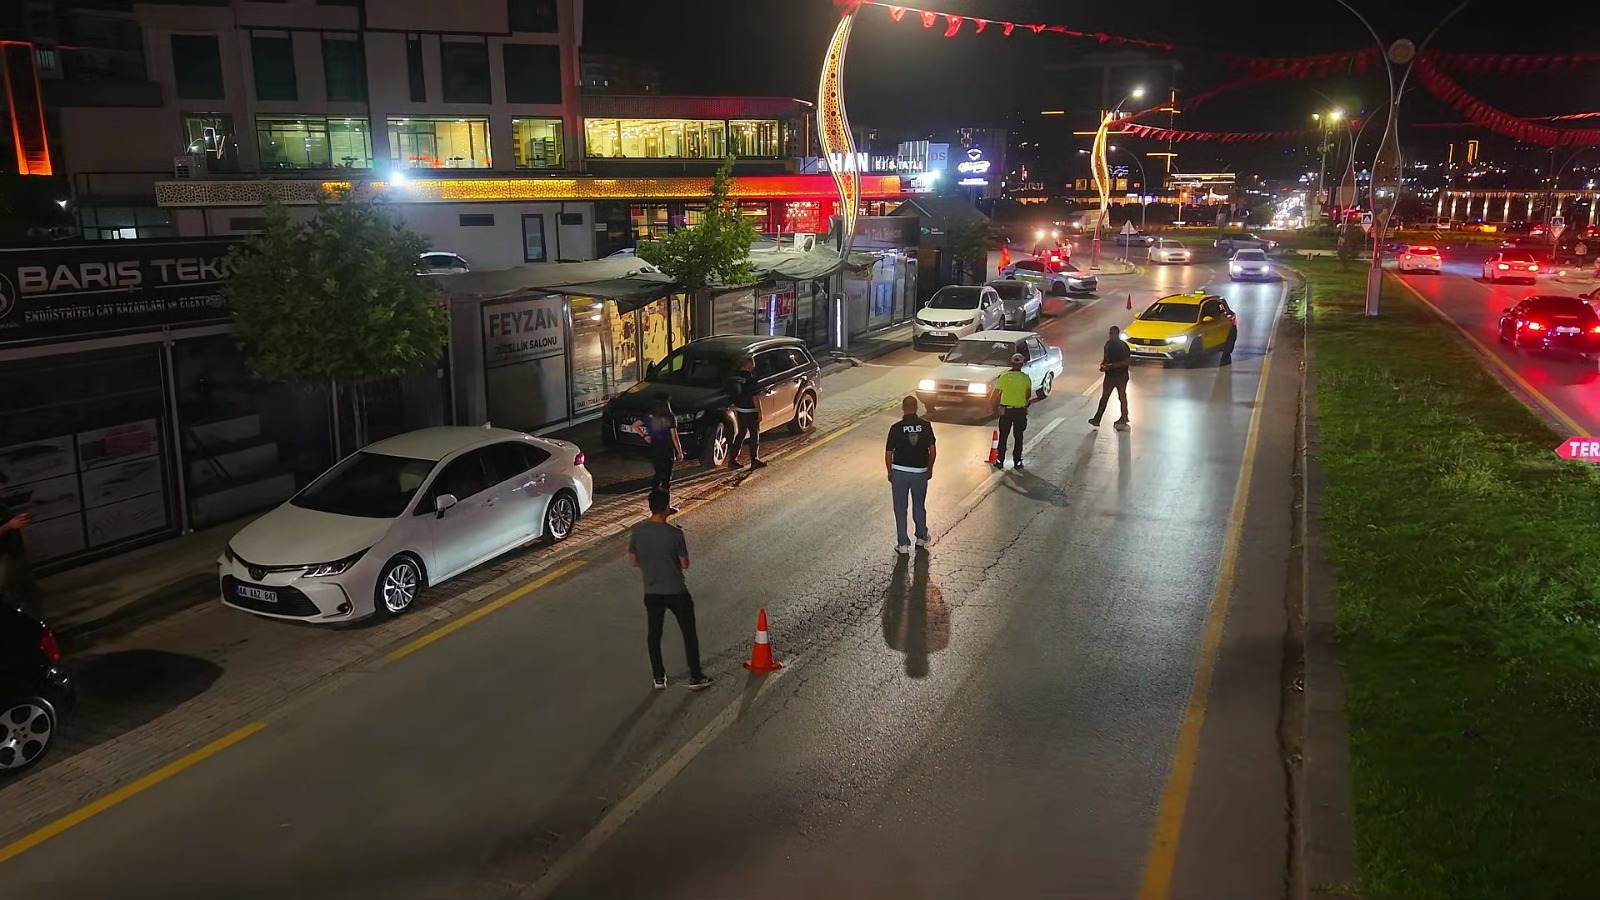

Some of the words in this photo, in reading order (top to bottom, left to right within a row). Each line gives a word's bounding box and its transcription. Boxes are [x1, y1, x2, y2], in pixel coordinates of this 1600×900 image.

[17, 260, 143, 293] BARIŞ
[489, 307, 558, 338] FEYZAN
[530, 336, 557, 349] SALONU
